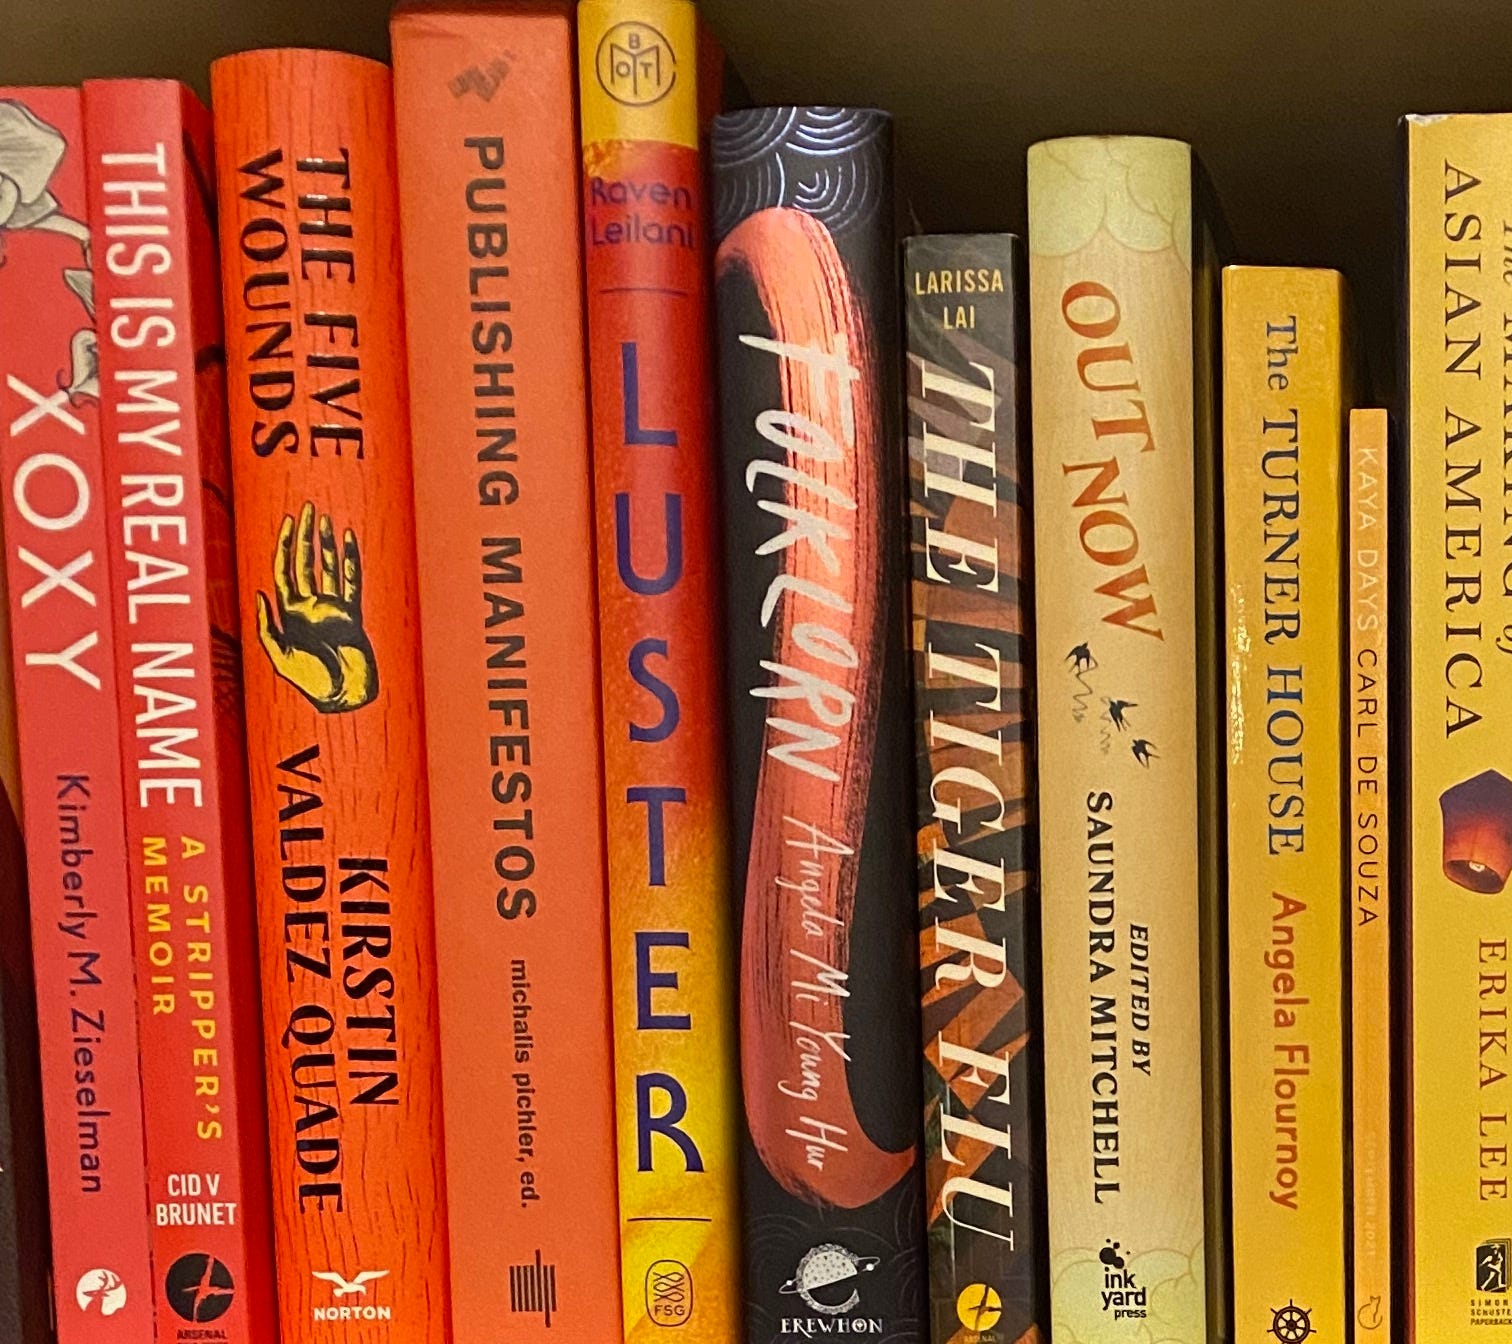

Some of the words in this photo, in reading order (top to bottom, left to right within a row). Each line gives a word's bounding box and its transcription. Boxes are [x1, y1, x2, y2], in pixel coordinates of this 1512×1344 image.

[101, 142, 166, 277] THIS
[111, 299, 175, 349] IS
[464, 136, 520, 506] PUBLISHING
[914, 270, 1004, 294] LARISSA
[942, 308, 975, 329] LAI
[1061, 280, 1155, 454] OUT
[1266, 314, 1298, 392] The
[116, 372, 181, 455] MY
[10, 373, 101, 691] XOXY
[120, 473, 191, 624] REAL
[1062, 455, 1165, 641] NOW
[1262, 408, 1304, 646] TURNER
[132, 642, 203, 809] NAME
[480, 535, 537, 921] MANIFESTOS
[1265, 663, 1306, 856] HOUSE
[1086, 791, 1117, 982] SAUNDRA
[337, 858, 400, 1106] KIRSTIN
[510, 959, 529, 1063] michalis
[1478, 938, 1508, 1089] ERIKA
[512, 1073, 531, 1163] pichler,
[1091, 997, 1121, 1204] MITCHELL
[168, 1174, 197, 1196] CID
[201, 1174, 219, 1196] V
[520, 1174, 541, 1207] ed.
[1478, 1113, 1508, 1200] LEE
[156, 1202, 236, 1226] BRUNET
[314, 1307, 391, 1320] NORTON
[780, 1317, 882, 1334] EREWHON
[1101, 1289, 1147, 1310] yard
[1104, 1269, 1135, 1289] ink
[1114, 1308, 1146, 1320] press
